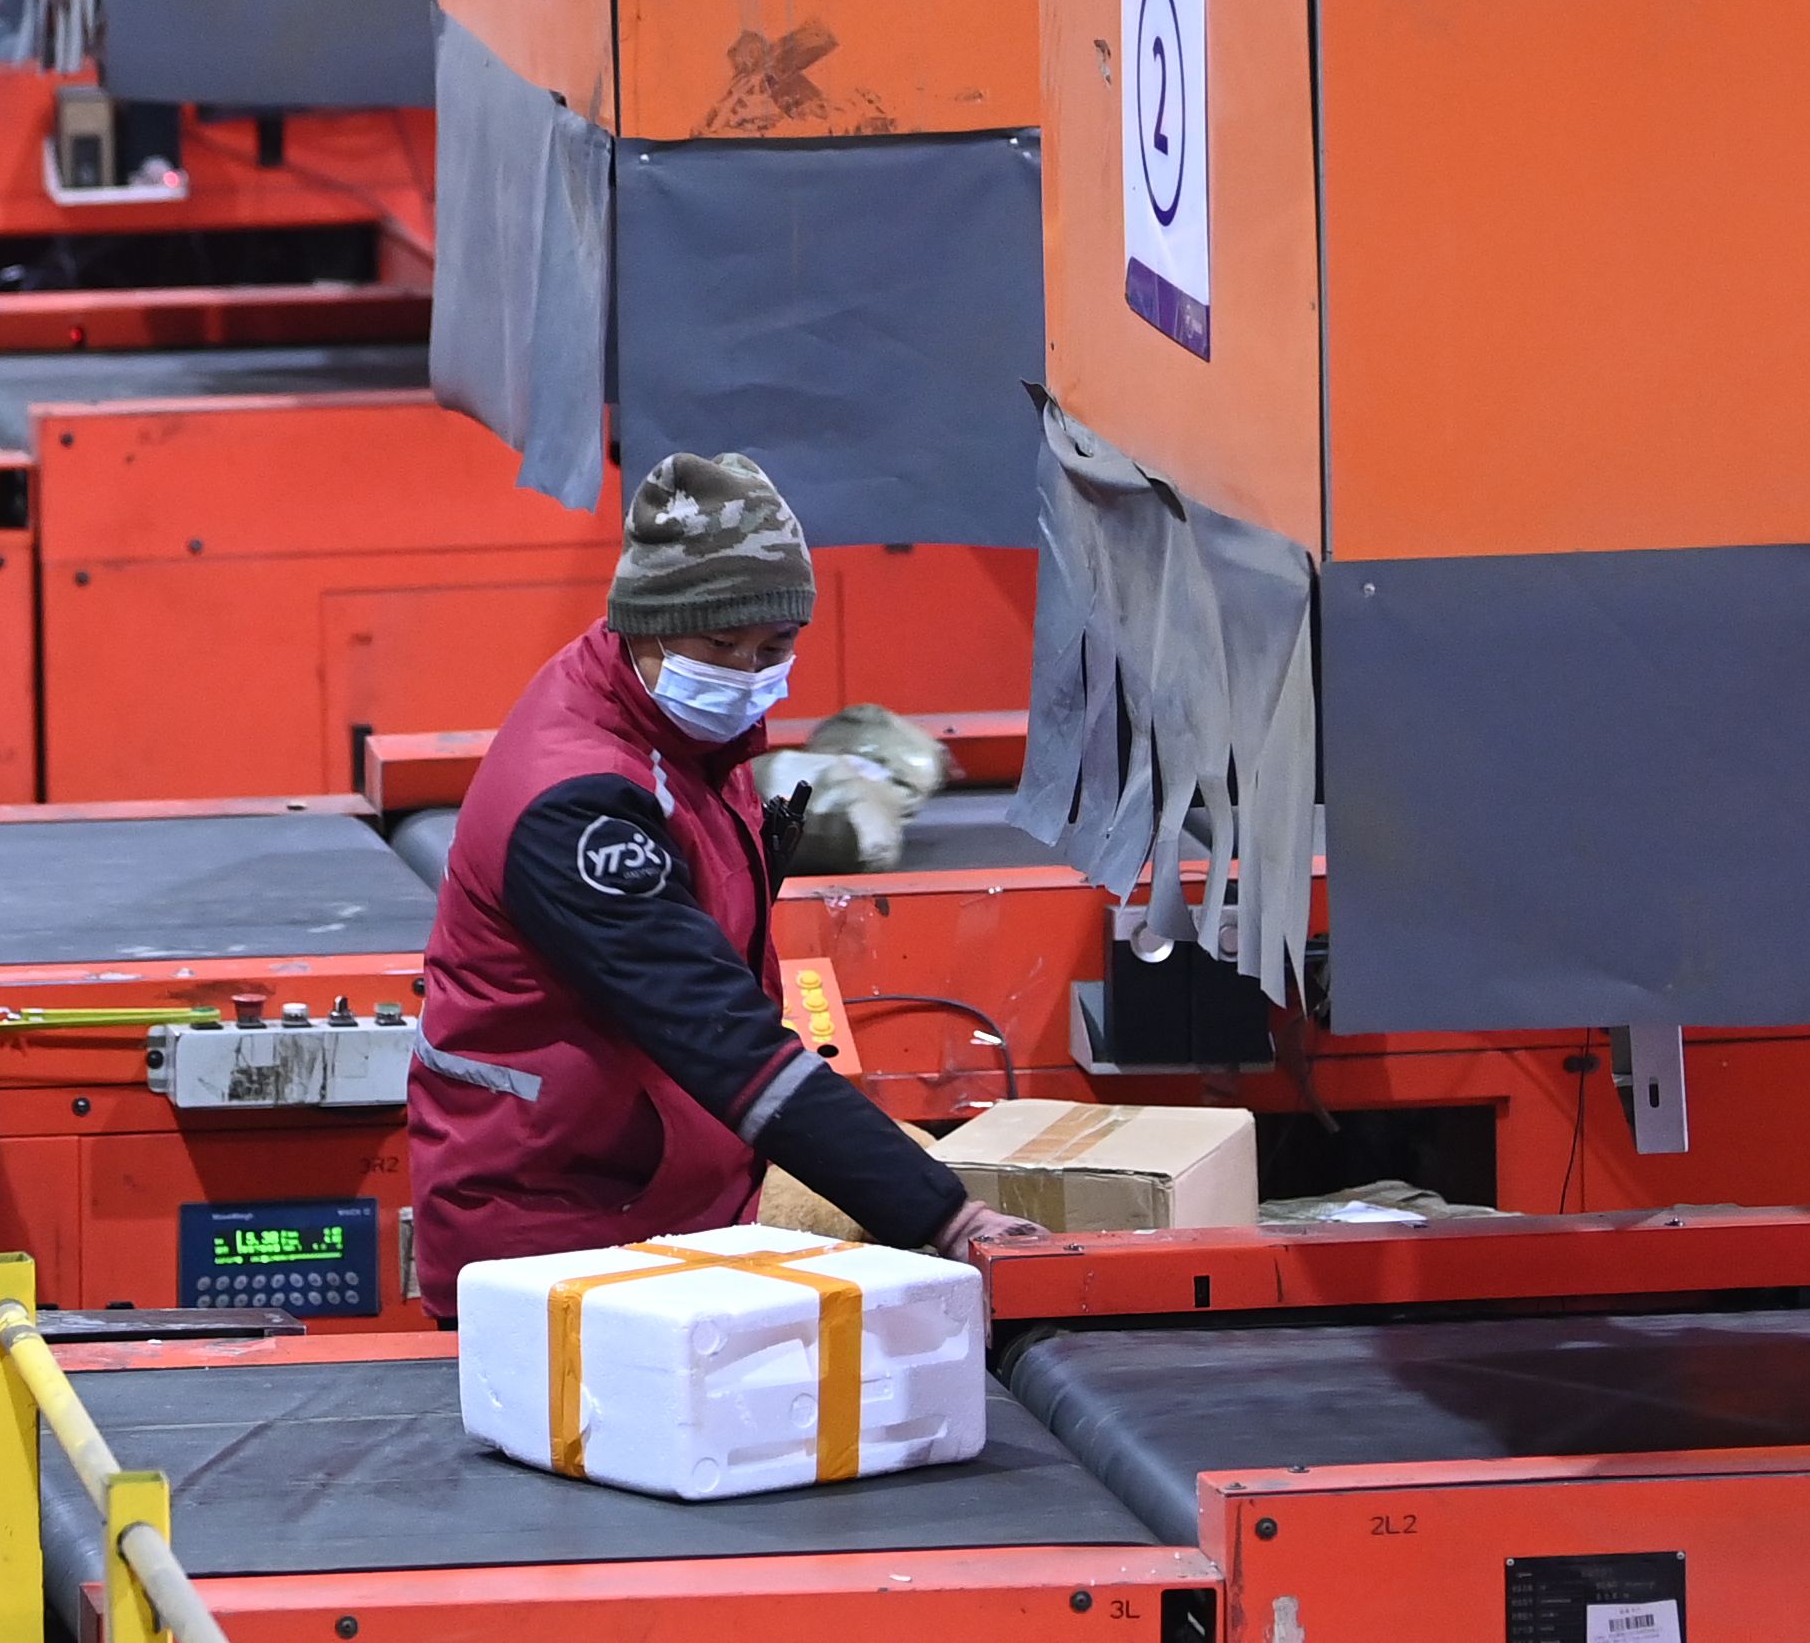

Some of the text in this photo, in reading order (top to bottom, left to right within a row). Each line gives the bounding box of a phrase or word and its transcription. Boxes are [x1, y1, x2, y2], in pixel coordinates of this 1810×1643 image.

[1151, 35, 1169, 157] 2
[1369, 1514, 1419, 1536] 2L2
[1110, 1599, 1141, 1620] 3L
